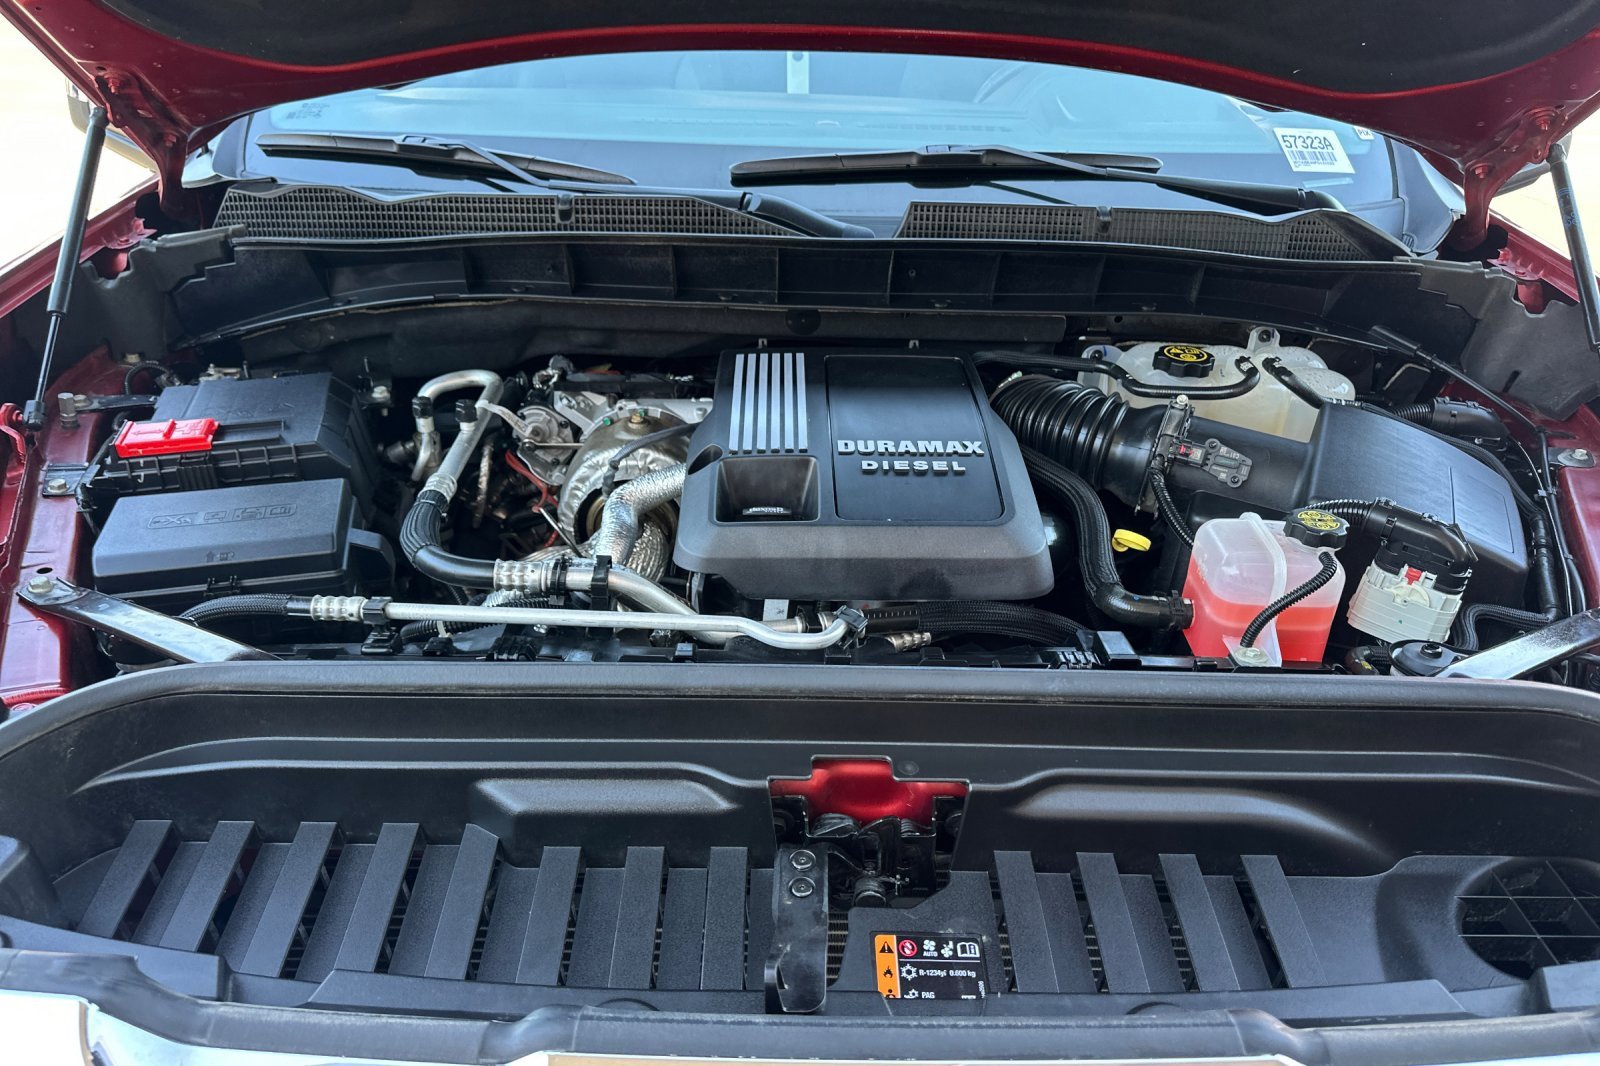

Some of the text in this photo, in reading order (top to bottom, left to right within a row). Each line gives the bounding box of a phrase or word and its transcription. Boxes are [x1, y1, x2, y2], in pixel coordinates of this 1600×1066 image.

[1281, 134, 1334, 151] 57323A
[837, 439, 985, 456] DURAMAX
[861, 460, 966, 473] DIESEL
[968, 970, 976, 978] kg
[921, 991, 936, 999] PAG
